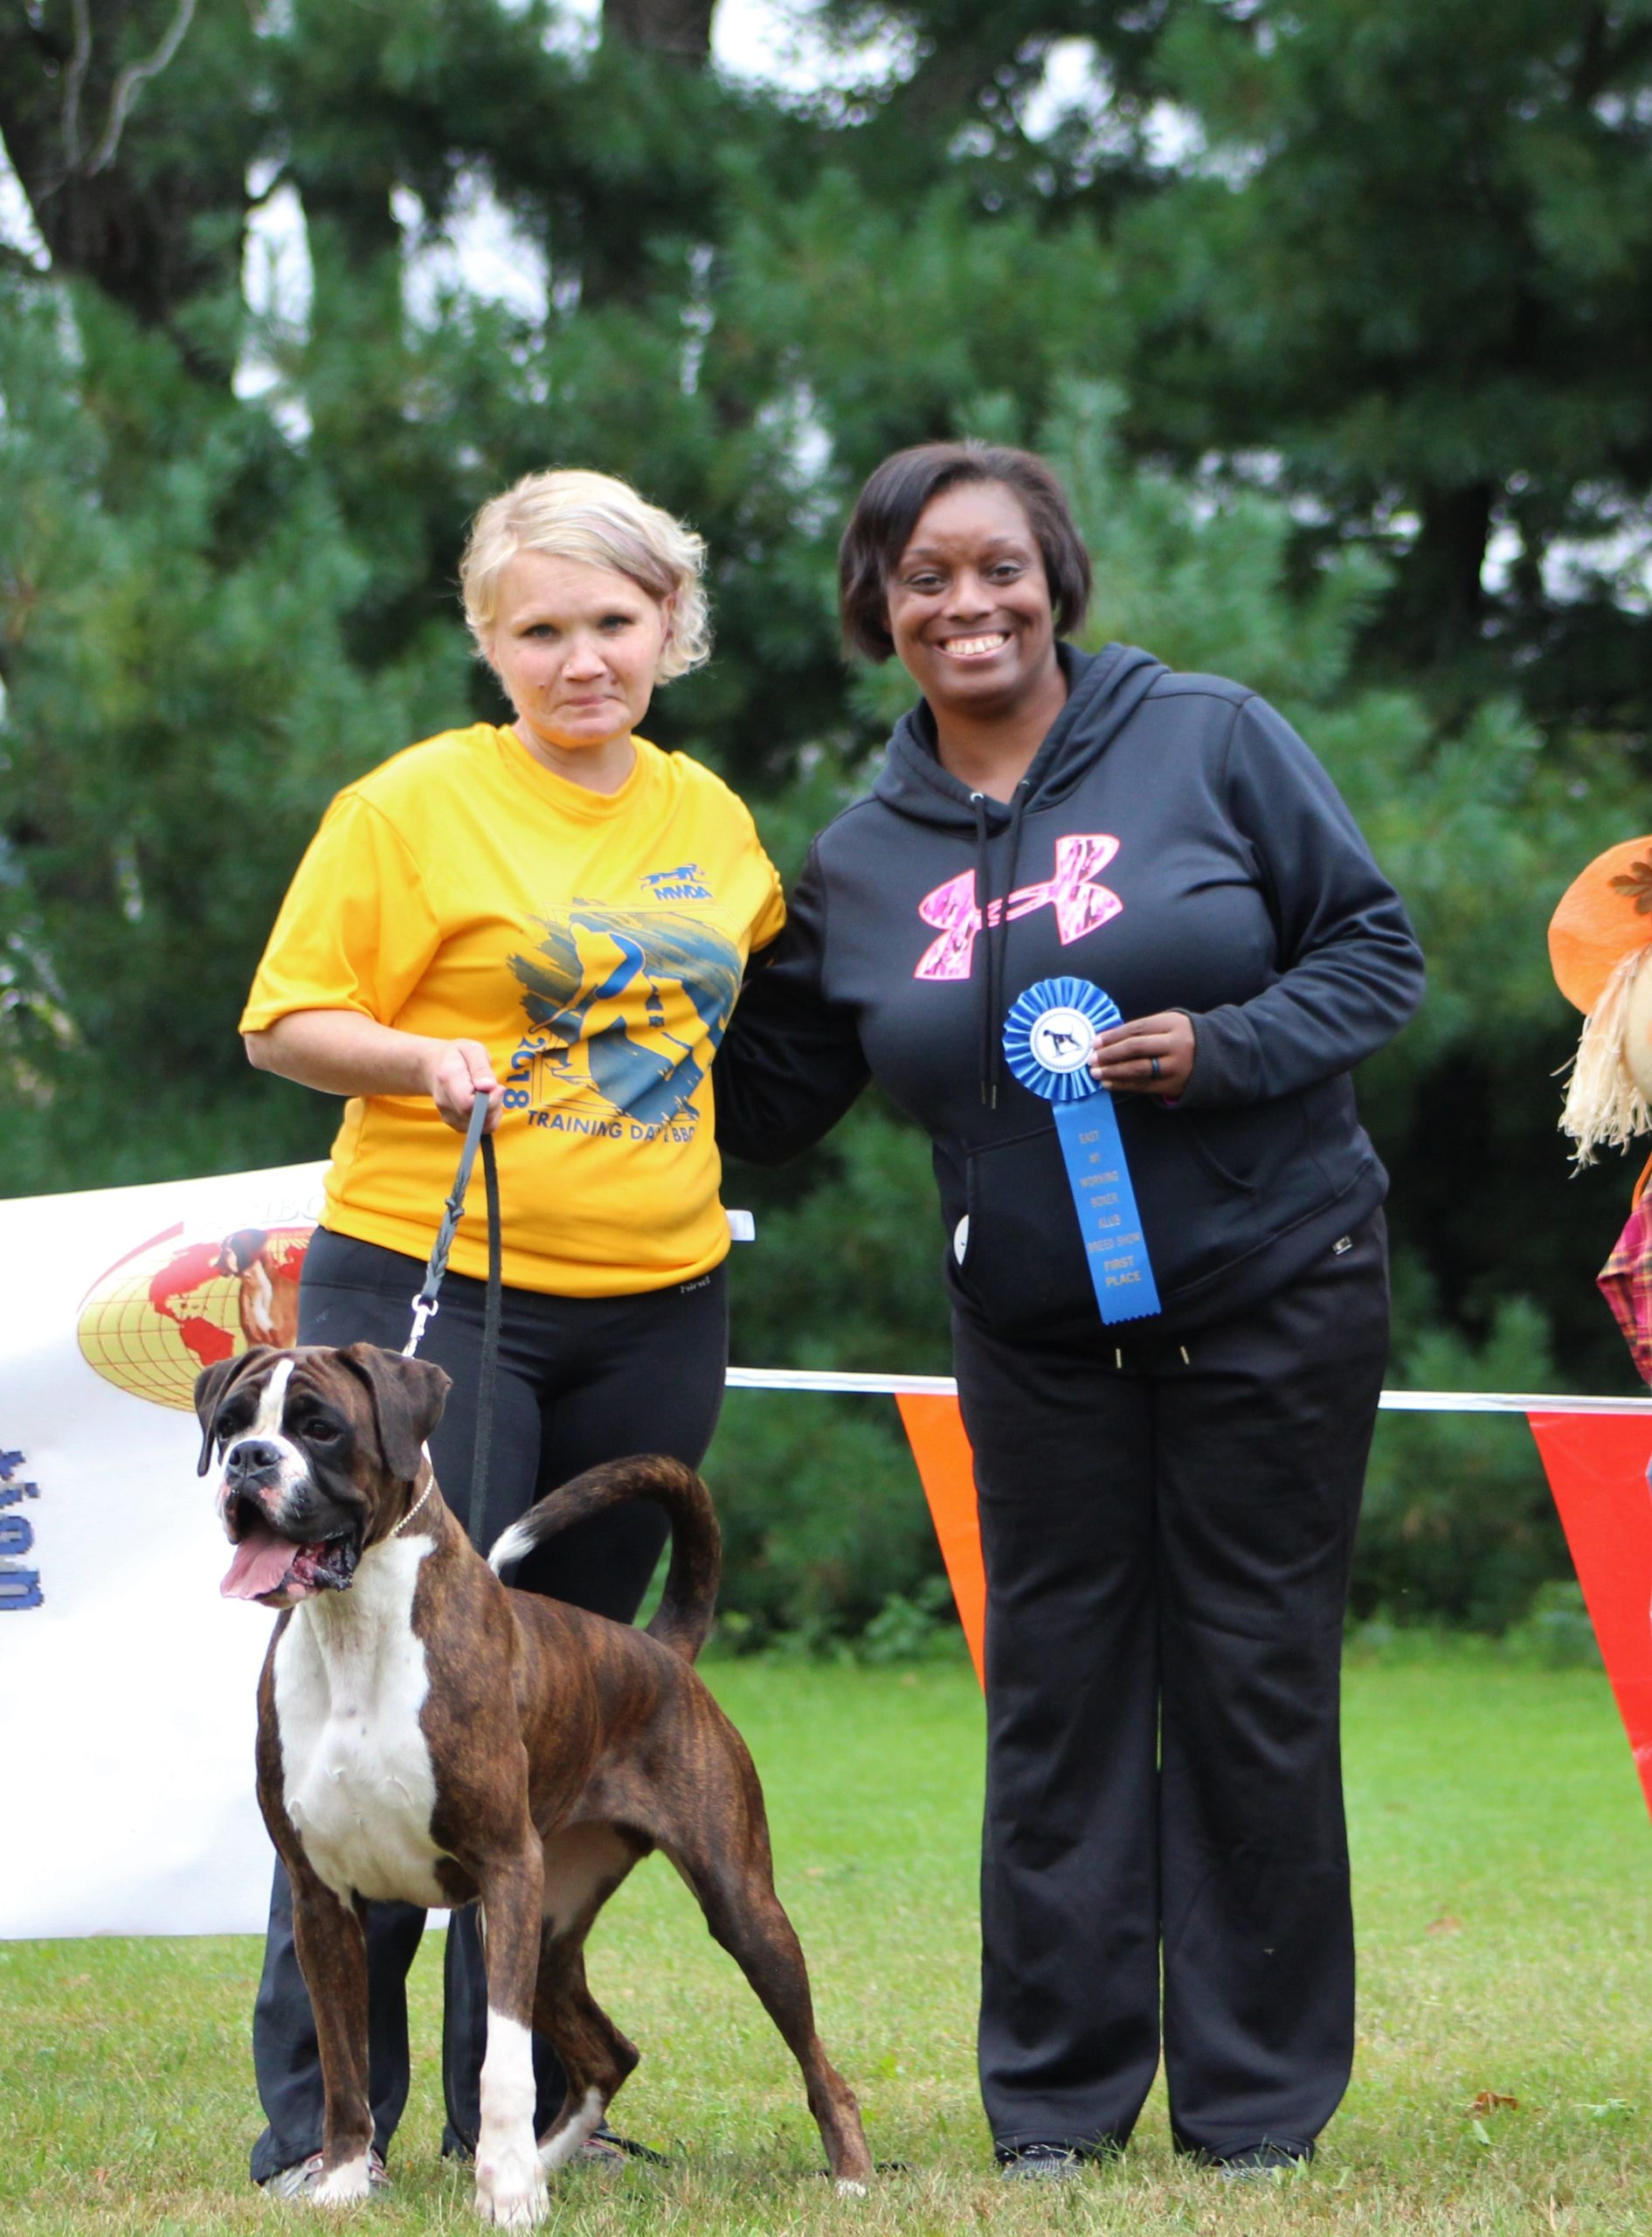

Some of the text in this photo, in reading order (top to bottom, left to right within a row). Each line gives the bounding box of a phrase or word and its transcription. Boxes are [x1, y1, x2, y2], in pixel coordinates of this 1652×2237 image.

[502, 1035, 545, 1109] 2018
[527, 1110, 623, 1139] TRAINING
[1103, 1256, 1134, 1271] FIRST
[1104, 1270, 1142, 1287] PLACE
